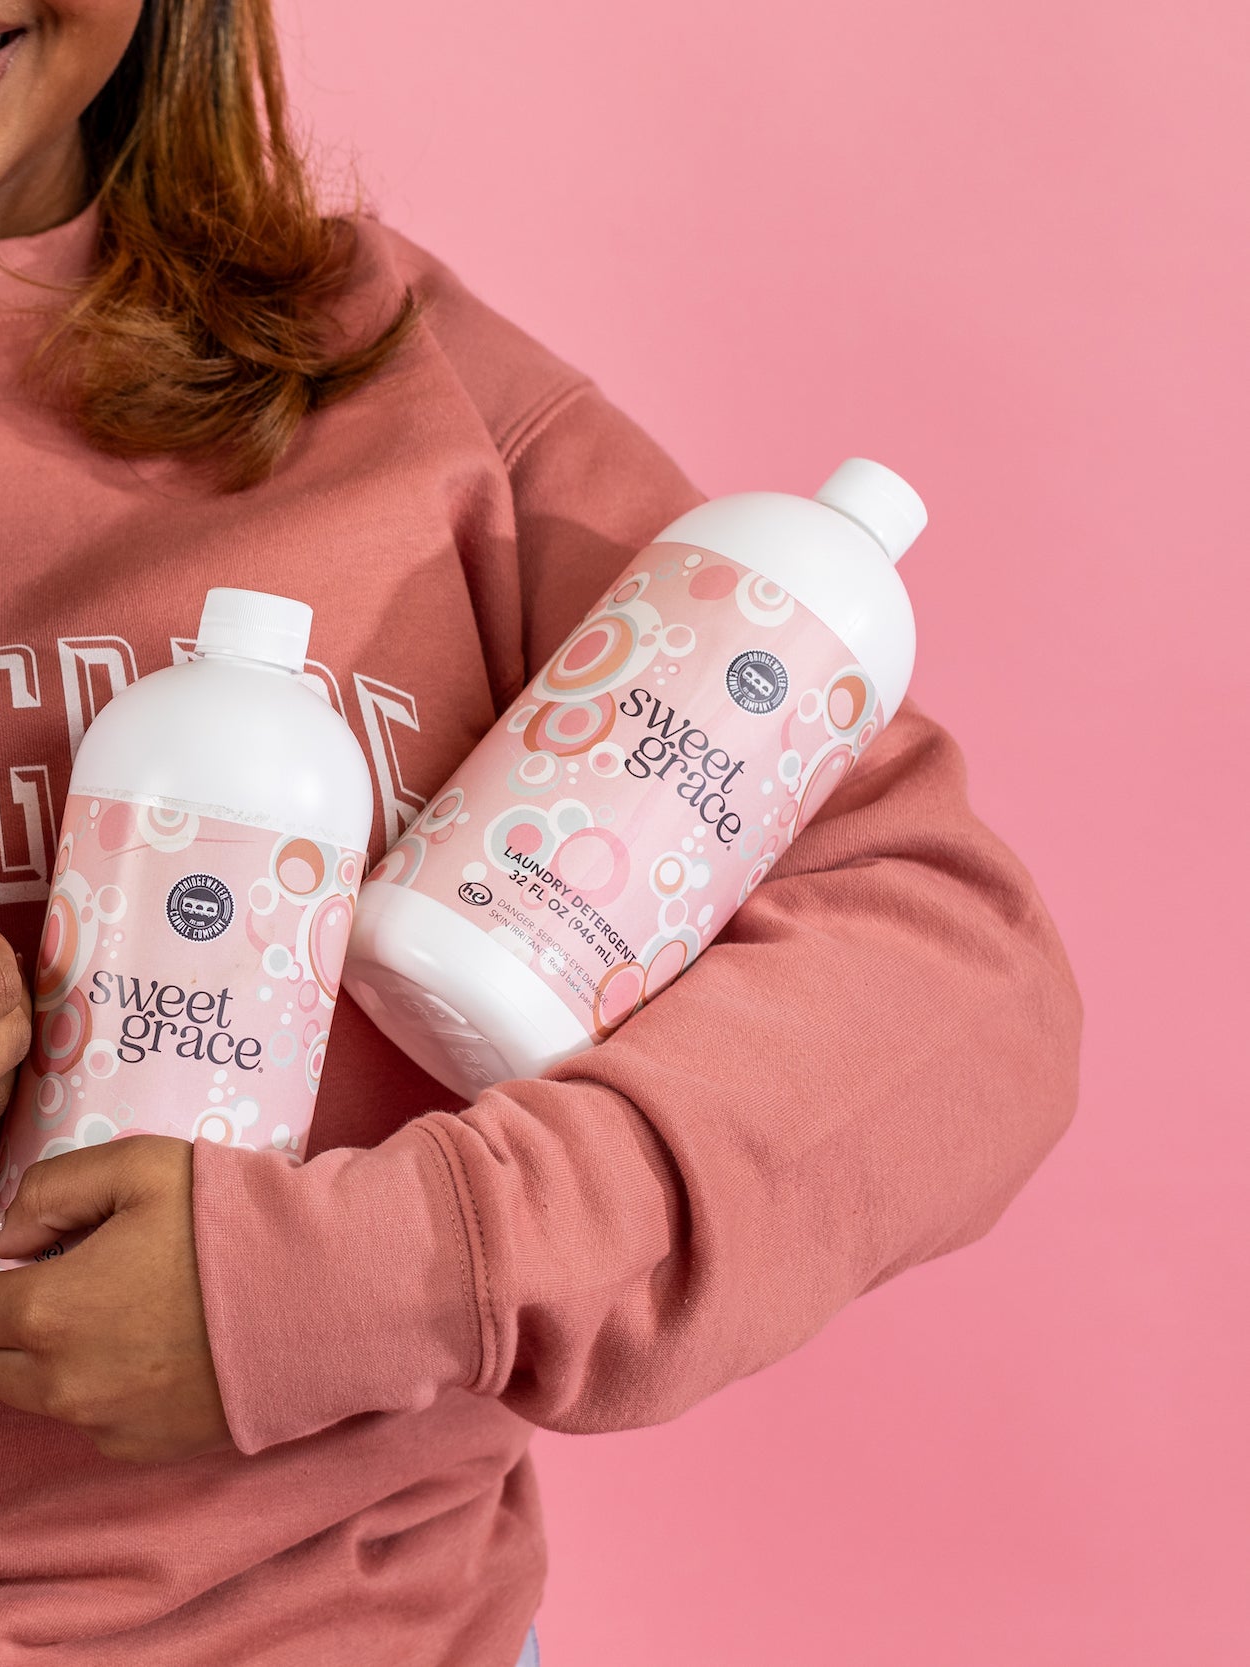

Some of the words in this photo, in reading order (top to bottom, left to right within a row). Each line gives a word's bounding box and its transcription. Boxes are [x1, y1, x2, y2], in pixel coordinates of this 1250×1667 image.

[729, 672, 742, 699] CANDLE
[740, 697, 771, 712] COMPANY
[748, 652, 786, 687] BRIDGEWATER
[619, 688, 745, 795] sweet
[178, 877, 229, 900] BRIDGEWATER
[503, 846, 572, 897] LAUNDRY
[571, 895, 637, 966] DETERGENT
[508, 869, 528, 887] 32
[528, 883, 545, 901] FL
[548, 898, 570, 919] OZ
[568, 916, 596, 945] (946
[594, 944, 616, 968] mL)
[170, 911, 191, 935] CANDLE
[193, 918, 226, 939] COMPANY
[489, 909, 511, 927] SKIN
[510, 925, 548, 960] IRRITANT.
[547, 957, 568, 977] Read
[566, 974, 582, 993] back
[497, 898, 536, 931] DANGER:
[536, 928, 571, 961] SERIOUS
[569, 959, 584, 976] EYE
[88, 970, 234, 1029] sweet
